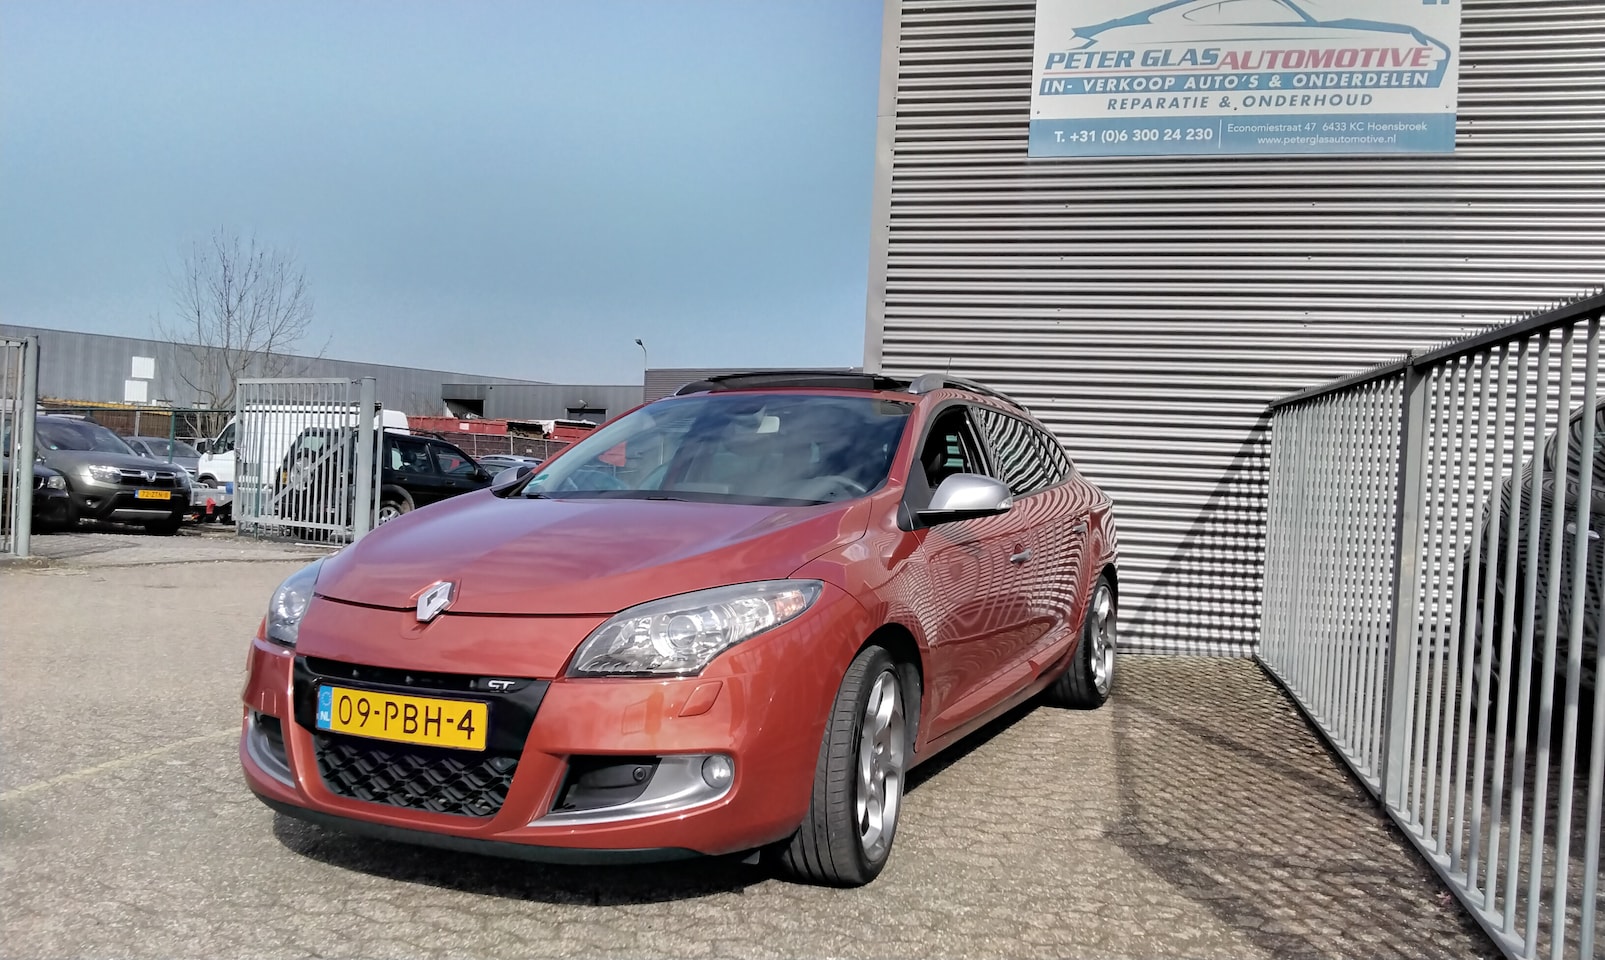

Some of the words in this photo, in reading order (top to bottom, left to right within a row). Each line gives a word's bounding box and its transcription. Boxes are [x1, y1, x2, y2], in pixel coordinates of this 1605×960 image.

[1044, 50, 1136, 70] PETER
[1043, 79, 1073, 93] IN-
[1083, 77, 1176, 92] VERKOOP
[1183, 74, 1259, 90] AUTO'S
[1268, 74, 1282, 88] &
[1292, 72, 1429, 88] ONDERDELEN
[1107, 96, 1210, 110] REPARATIE
[1218, 95, 1231, 108] &
[1242, 94, 1373, 108] ONDERHOUD
[1227, 123, 1302, 133] Economiestraat
[1304, 122, 1316, 132] 47
[1322, 122, 1347, 132] 6433
[1349, 122, 1365, 131] KC
[1367, 121, 1428, 131] Hoensbroek
[1054, 131, 1065, 143] T.
[1069, 130, 1096, 142] +31
[1101, 129, 1128, 144] (0)6
[1132, 128, 1159, 142] 300
[1163, 128, 1182, 141] 24
[1185, 128, 1213, 141] 230
[1257, 134, 1396, 146] www.peterglasautomotive.nl
[320, 710, 330, 722] NL
[338, 695, 475, 740] 09-PBH-4
